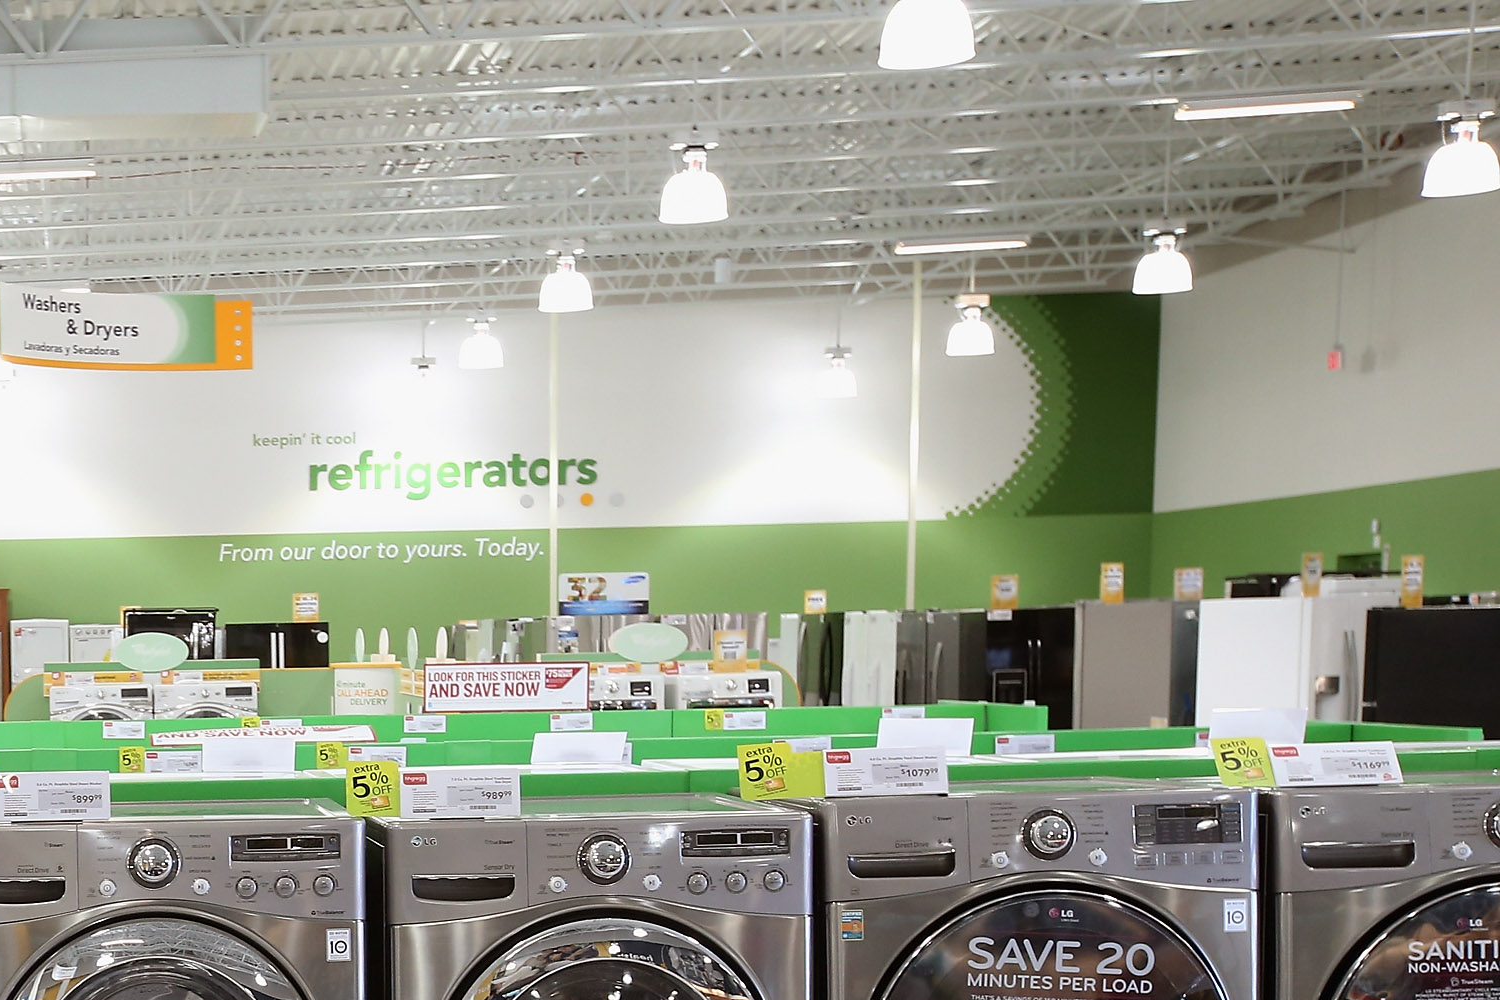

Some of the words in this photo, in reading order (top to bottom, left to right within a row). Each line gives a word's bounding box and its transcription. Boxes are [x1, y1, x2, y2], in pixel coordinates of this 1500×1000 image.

[22, 293, 81, 314] Washers
[66, 319, 78, 335] &
[84, 320, 139, 341] Dryers
[24, 340, 63, 354] Lavadoras
[65, 345, 71, 356] y
[73, 344, 120, 357] Secadoras
[252, 433, 307, 449] keepin'
[311, 434, 322, 446] it
[326, 432, 357, 446] cool
[308, 449, 598, 501] refrigerators
[219, 543, 273, 562] From
[280, 544, 316, 561] our
[321, 540, 371, 560] door
[377, 542, 399, 559] to
[403, 541, 467, 563] yours.
[474, 536, 544, 562] Today.
[567, 576, 607, 601] 32
[428, 671, 454, 682] LOOK
[456, 671, 475, 682] FOR
[477, 671, 499, 681] THIS
[500, 670, 541, 681] STICKER
[355, 689, 388, 697] AHEAD
[429, 683, 460, 698] AND
[463, 682, 501, 697] SAVE
[504, 682, 541, 697] NOW
[745, 746, 773, 758] extra
[1220, 740, 1248, 750] extra
[1221, 747, 1258, 771] 5%
[1243, 758, 1265, 768] OFF
[354, 763, 380, 774] extra
[744, 754, 783, 782] 5%
[766, 766, 787, 779] OFF
[352, 772, 389, 798] 5%
[372, 785, 393, 796] OFF
[859, 816, 872, 824] LG
[424, 837, 437, 846] LG
[1061, 909, 1074, 918] LG
[1227, 910, 1245, 924] 10
[1469, 919, 1483, 927] LG
[330, 940, 348, 954] 10
[1408, 939, 1500, 961] SANITI
[967, 936, 1081, 973] SAVE
[1096, 941, 1156, 977] 20
[1408, 961, 1500, 974] NON-WASHA
[966, 972, 1053, 991] MINUTES
[1059, 976, 1097, 992] PER
[1102, 978, 1153, 994] LOAD
